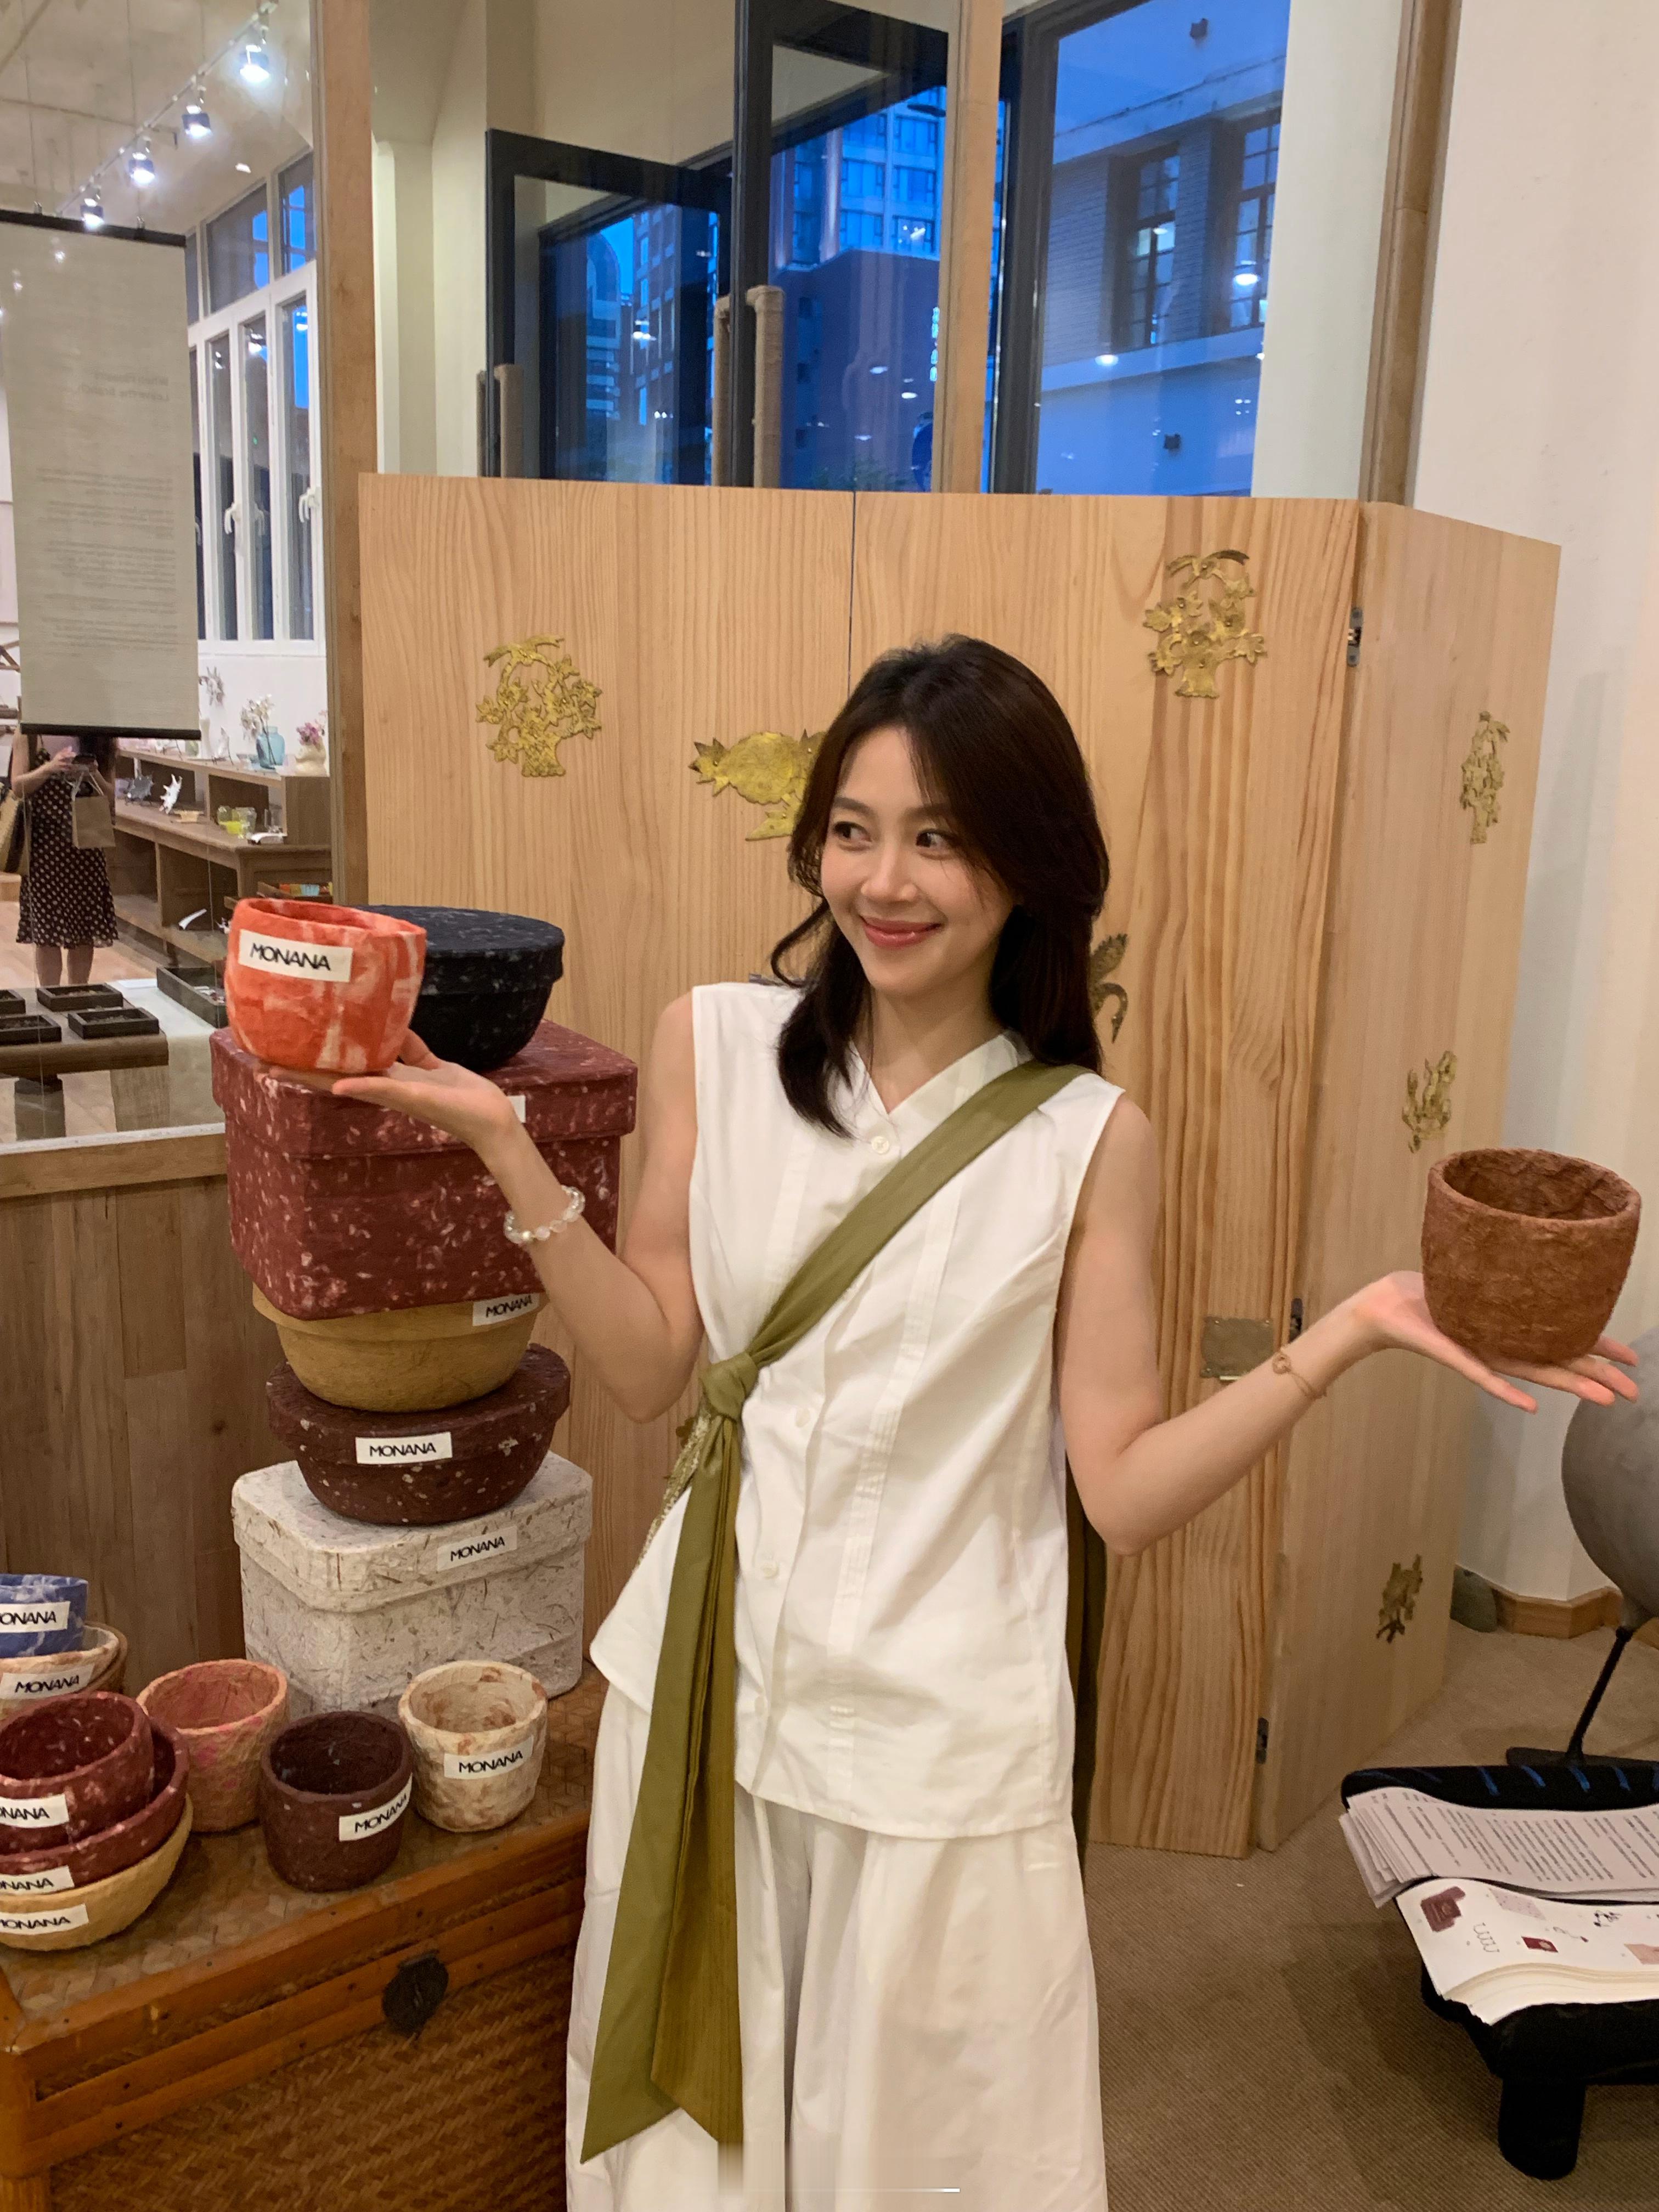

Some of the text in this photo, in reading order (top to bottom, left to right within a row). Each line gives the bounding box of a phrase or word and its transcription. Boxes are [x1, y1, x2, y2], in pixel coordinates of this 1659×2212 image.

[250, 942, 331, 972] MONANA
[486, 1294, 533, 1318] MONANA
[369, 1442, 437, 1457] MONANA
[450, 1536, 505, 1561] MONANA
[0, 1611, 57, 1625] ONANA
[15, 1674, 80, 1694] MONANA
[458, 1750, 523, 1774] MONANA
[0, 1807, 50, 1820] NANA
[0, 1877, 54, 1890] NANA
